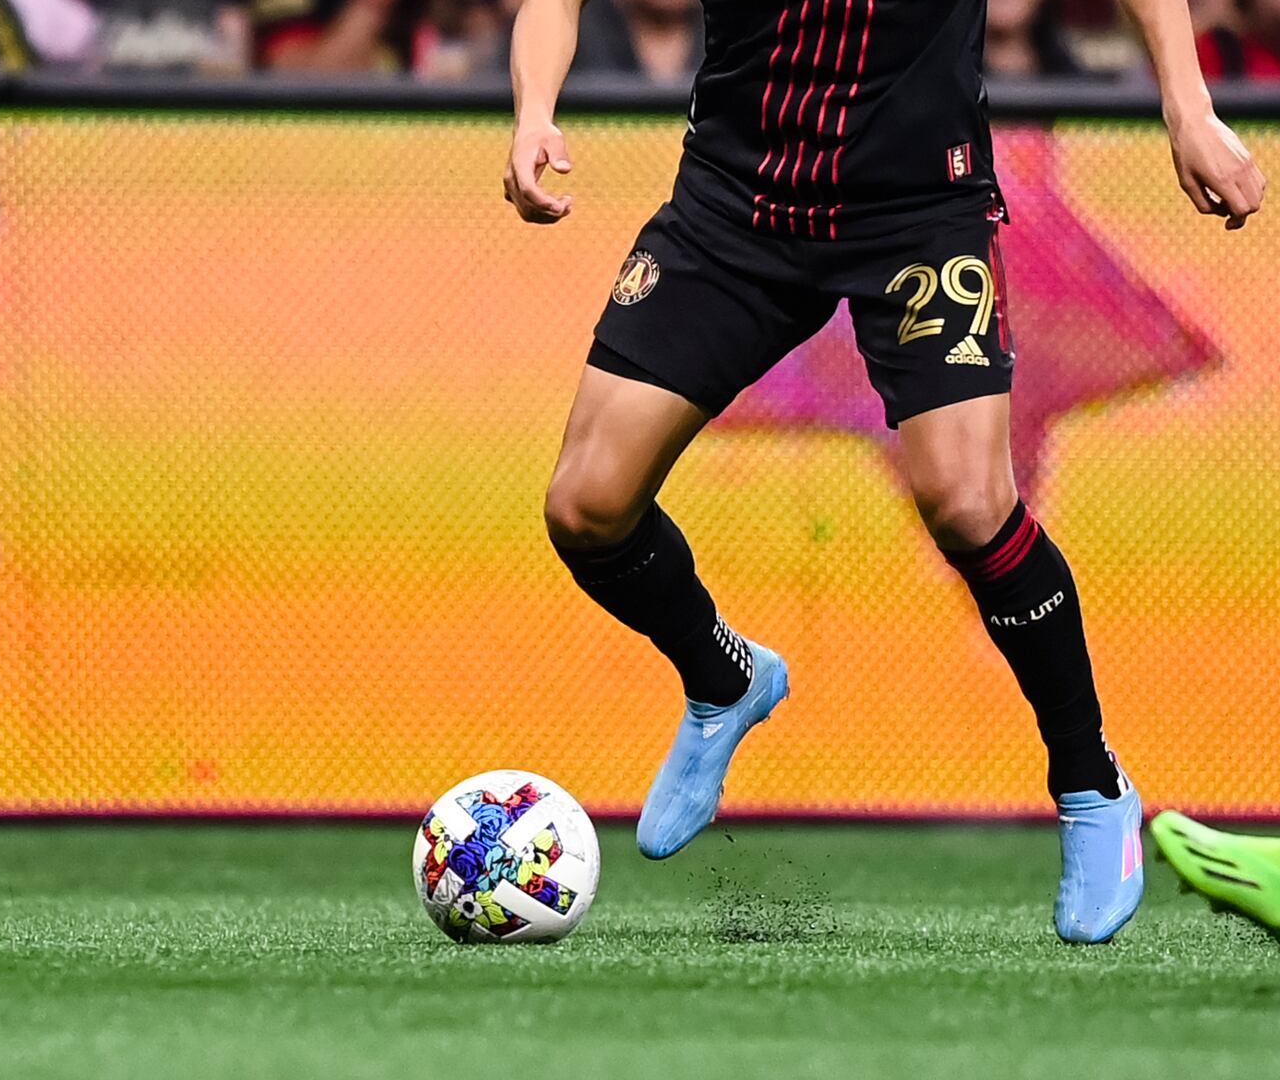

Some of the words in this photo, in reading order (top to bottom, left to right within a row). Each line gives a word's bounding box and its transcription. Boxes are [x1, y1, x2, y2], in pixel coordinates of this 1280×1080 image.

[884, 254, 995, 346] 29
[944, 353, 991, 368] adidas
[1029, 589, 1065, 621] UTD
